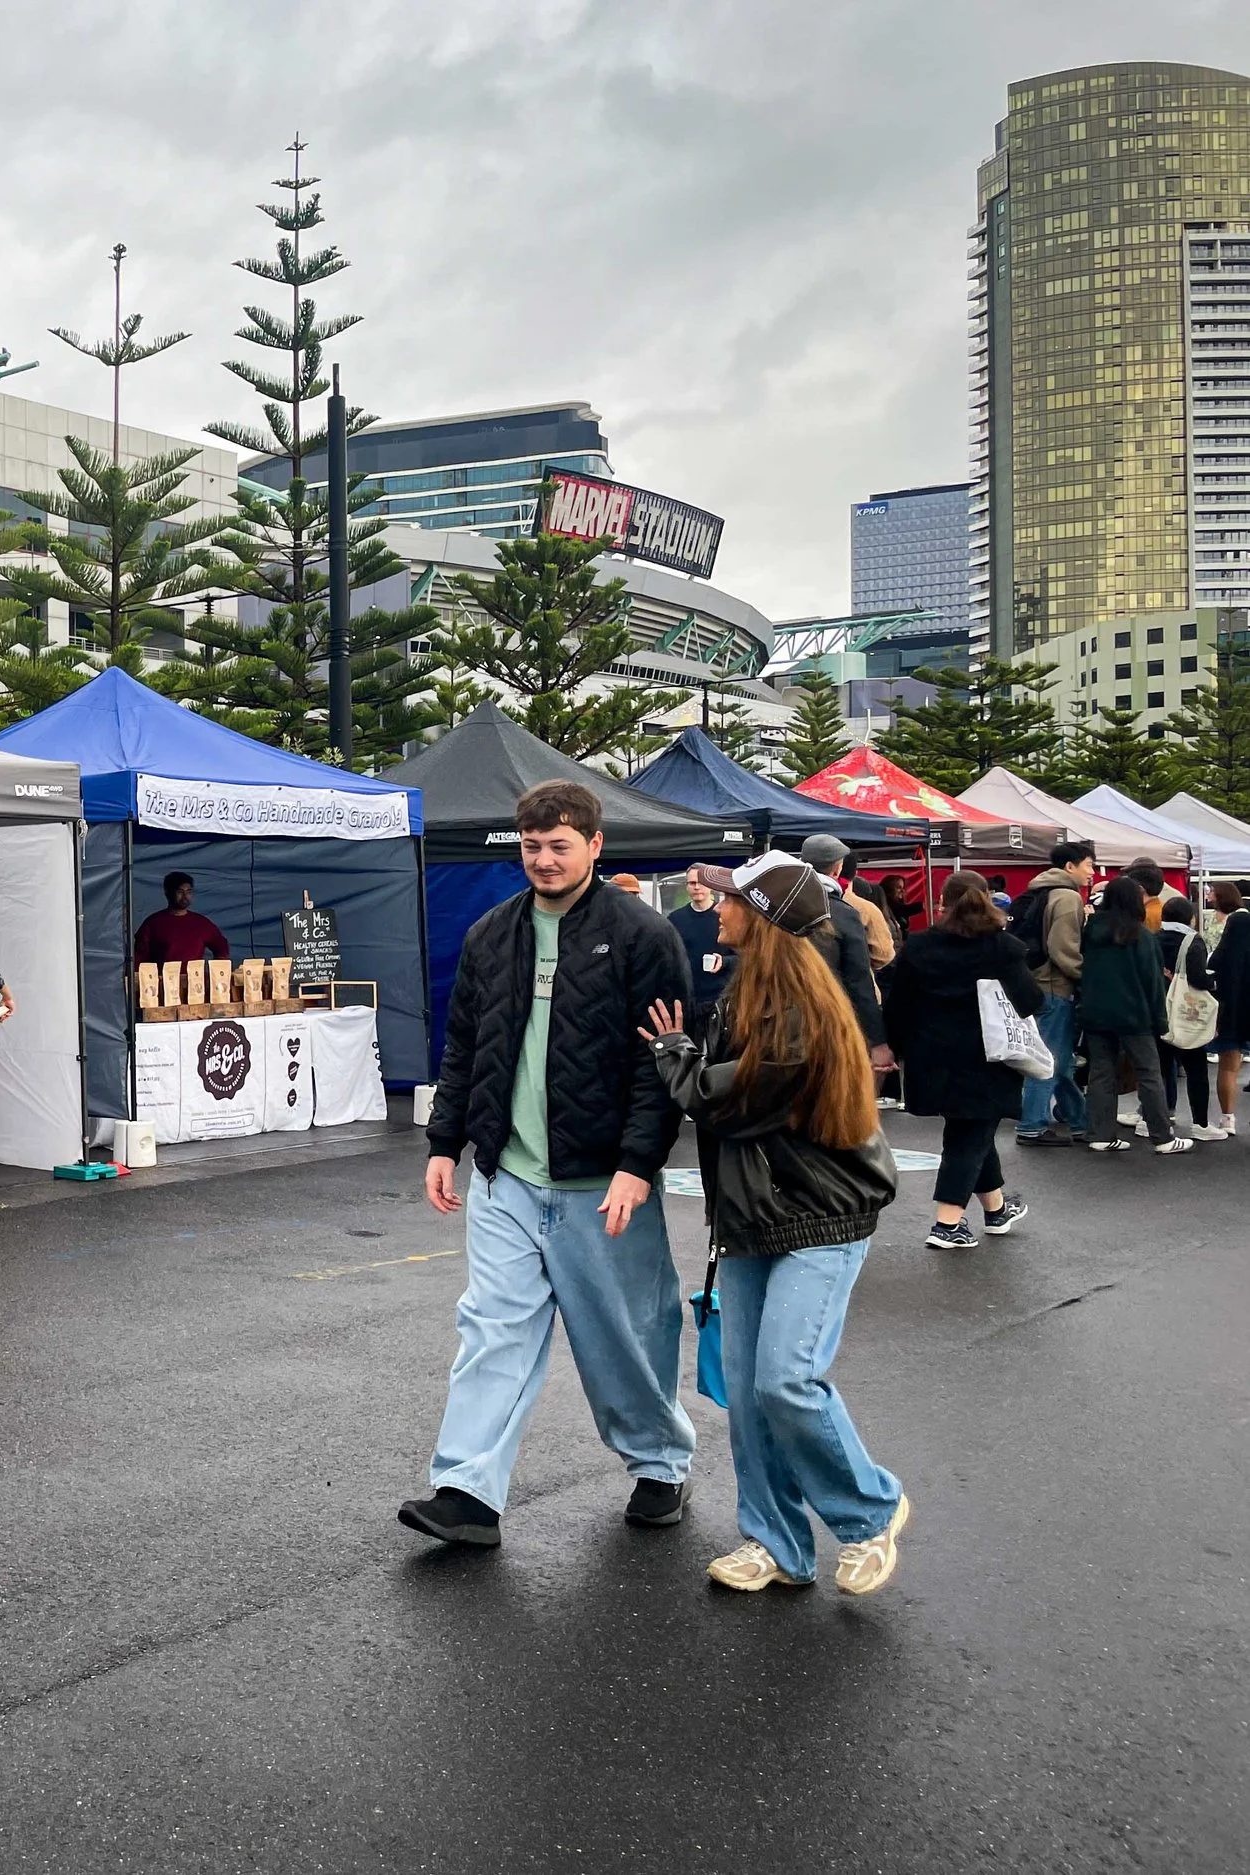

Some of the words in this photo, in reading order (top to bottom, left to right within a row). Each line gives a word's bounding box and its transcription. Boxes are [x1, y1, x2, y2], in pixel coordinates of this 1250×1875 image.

[855, 506, 887, 517] KPMG
[550, 479, 628, 544] MARVEL
[629, 502, 713, 564] STADIUM
[14, 784, 50, 797] DUNE
[145, 790, 177, 817] The
[181, 796, 214, 818] Mrs
[217, 799, 228, 821] &
[232, 800, 253, 822] Co
[257, 800, 344, 824] Handmade
[348, 805, 402, 829] Granola
[485, 831, 522, 845] ALTEGRA
[313, 912, 330, 927] Mrs
[1006, 1027, 1022, 1044] BIG
[205, 1053, 222, 1076] MRS
[220, 1044, 235, 1076] &
